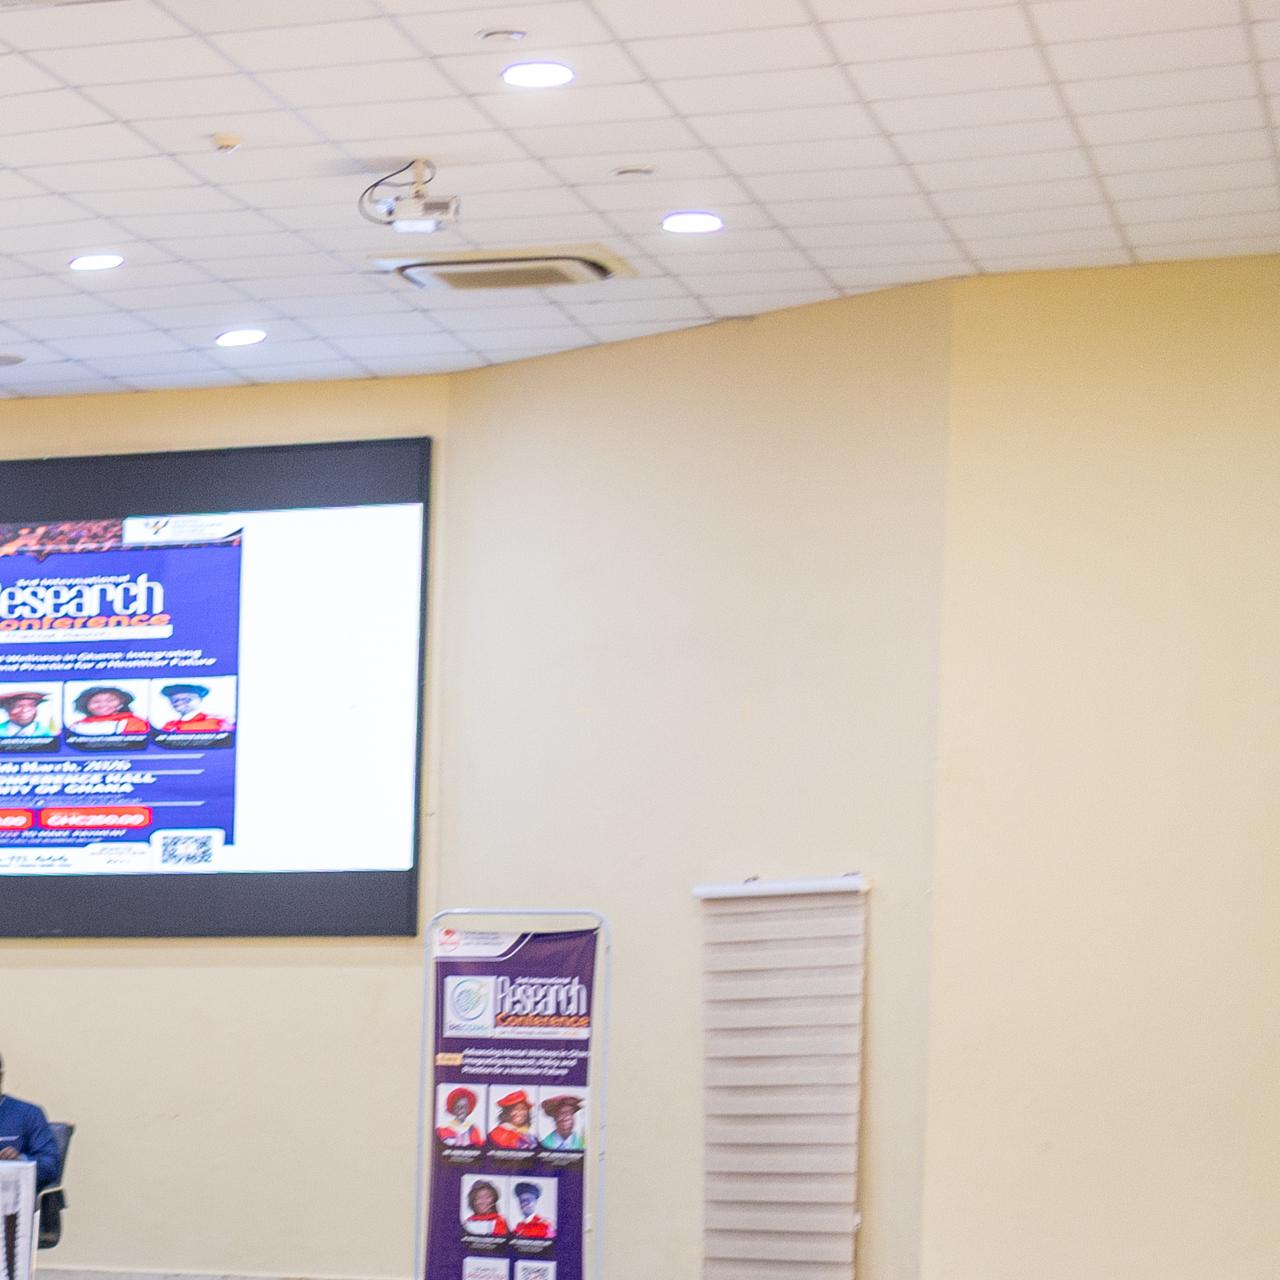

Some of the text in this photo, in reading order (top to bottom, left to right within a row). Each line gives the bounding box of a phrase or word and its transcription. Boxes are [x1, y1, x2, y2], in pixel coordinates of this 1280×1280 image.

[104, 771, 158, 785] HALL
[63, 782, 135, 794] GHANA
[496, 975, 587, 1016] Research
[496, 1012, 591, 1027] Conference
